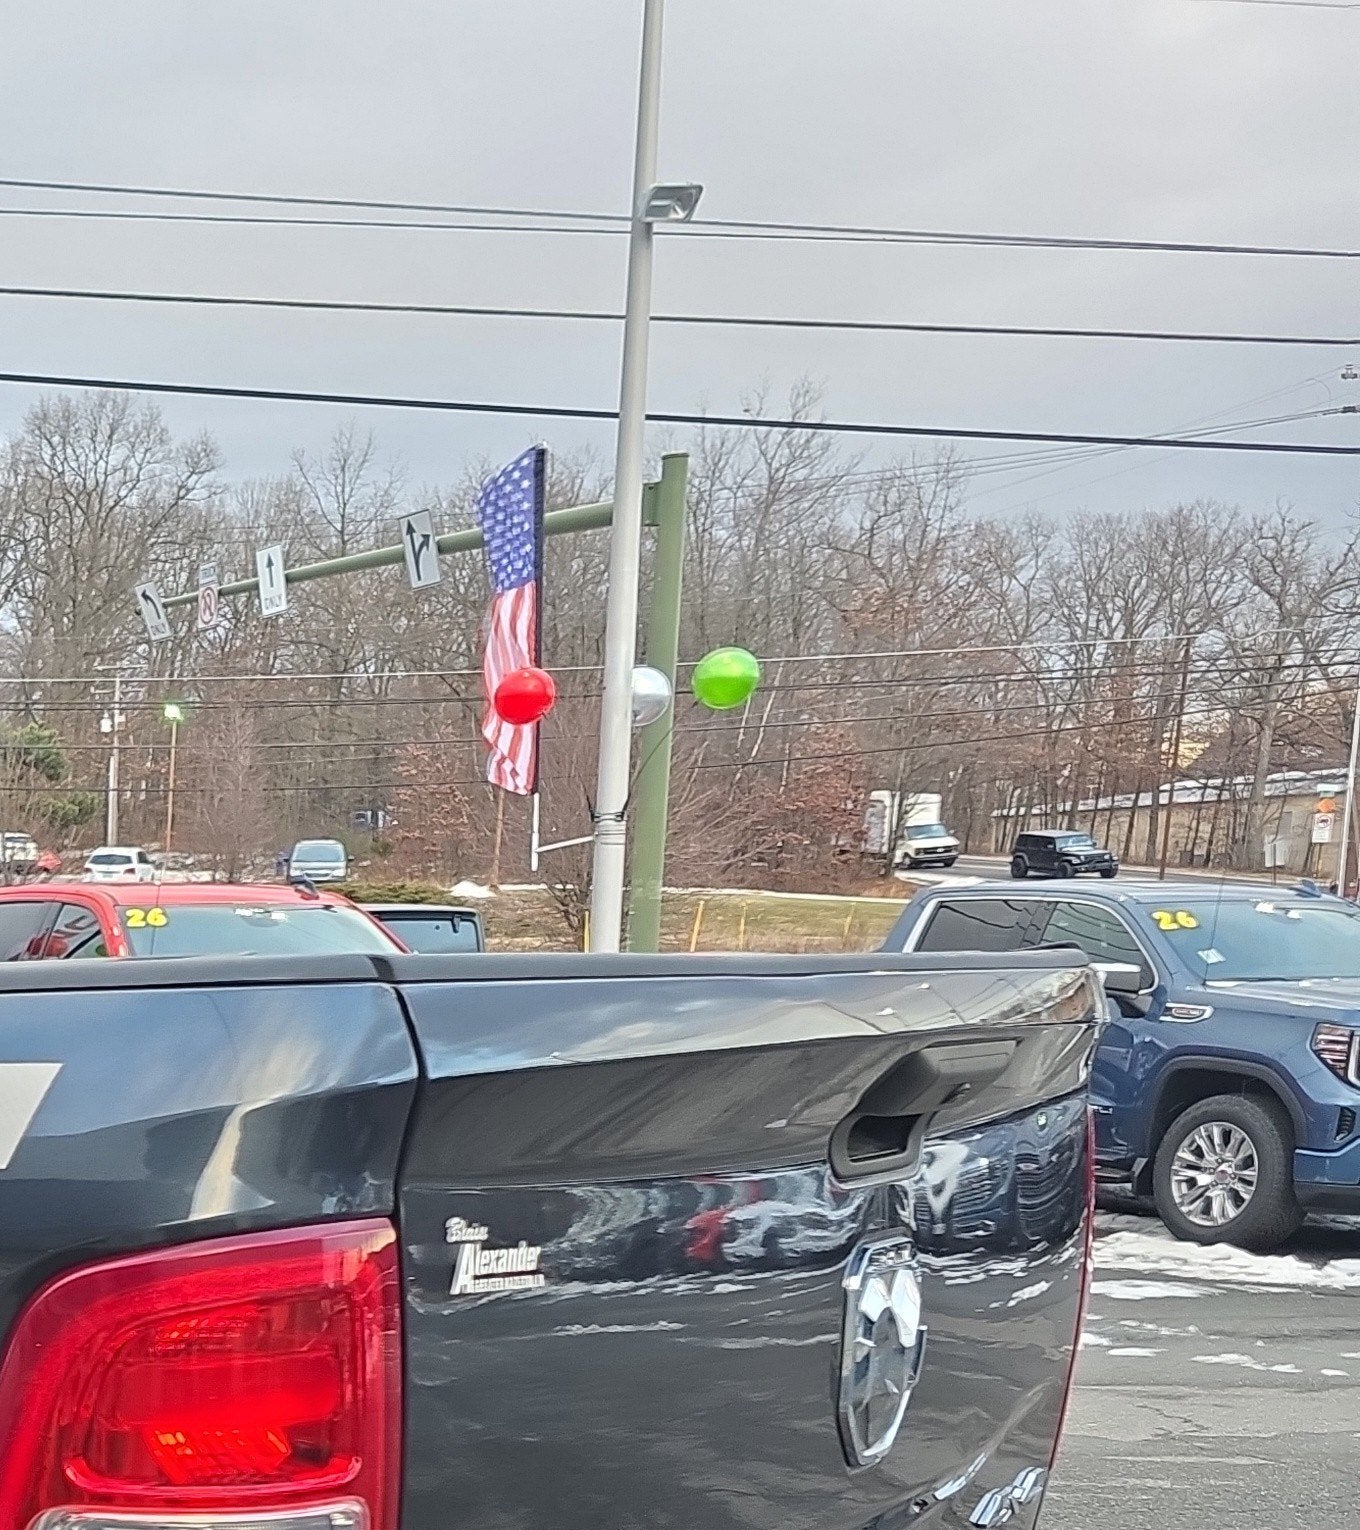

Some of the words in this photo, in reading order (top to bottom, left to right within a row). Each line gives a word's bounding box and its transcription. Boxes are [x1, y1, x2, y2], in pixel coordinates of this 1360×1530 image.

[125, 907, 168, 928] 26
[1151, 910, 1199, 931] 26
[450, 1240, 541, 1295] Alexander
